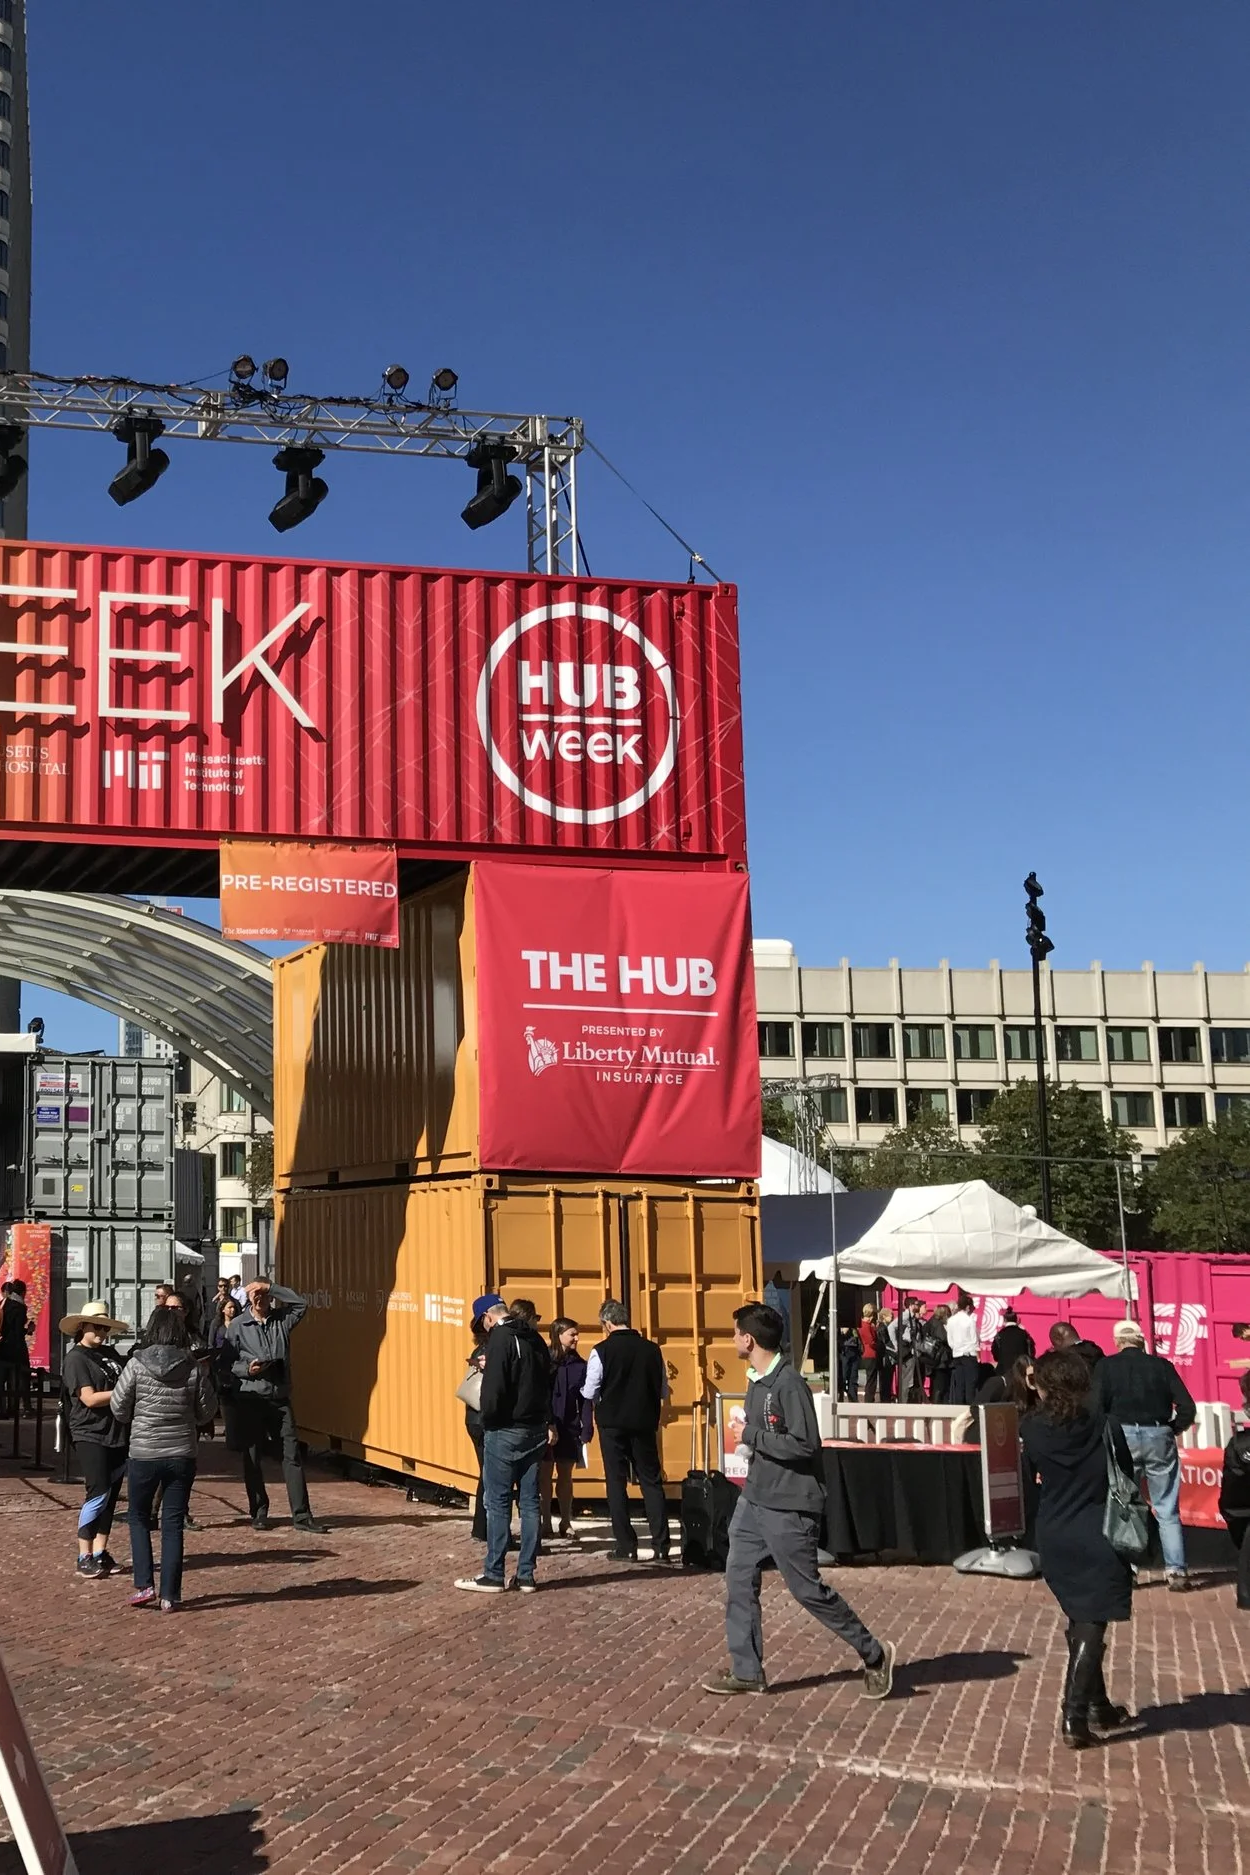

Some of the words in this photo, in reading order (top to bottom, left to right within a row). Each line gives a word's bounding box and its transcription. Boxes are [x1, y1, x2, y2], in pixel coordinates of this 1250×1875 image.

[518, 659, 642, 710] HUB
[184, 752, 266, 766] Massachusetts
[184, 766, 231, 778] Institute
[232, 769, 243, 780] of
[183, 780, 246, 796] Technology
[221, 874, 398, 898] PRE-REGISTERED
[521, 950, 607, 992] THE
[618, 955, 717, 996] HUB
[581, 1025, 646, 1037] PRESENTED
[649, 1028, 664, 1037] BY
[562, 1041, 637, 1069] Liberty
[596, 1071, 683, 1084] INSURANCE
